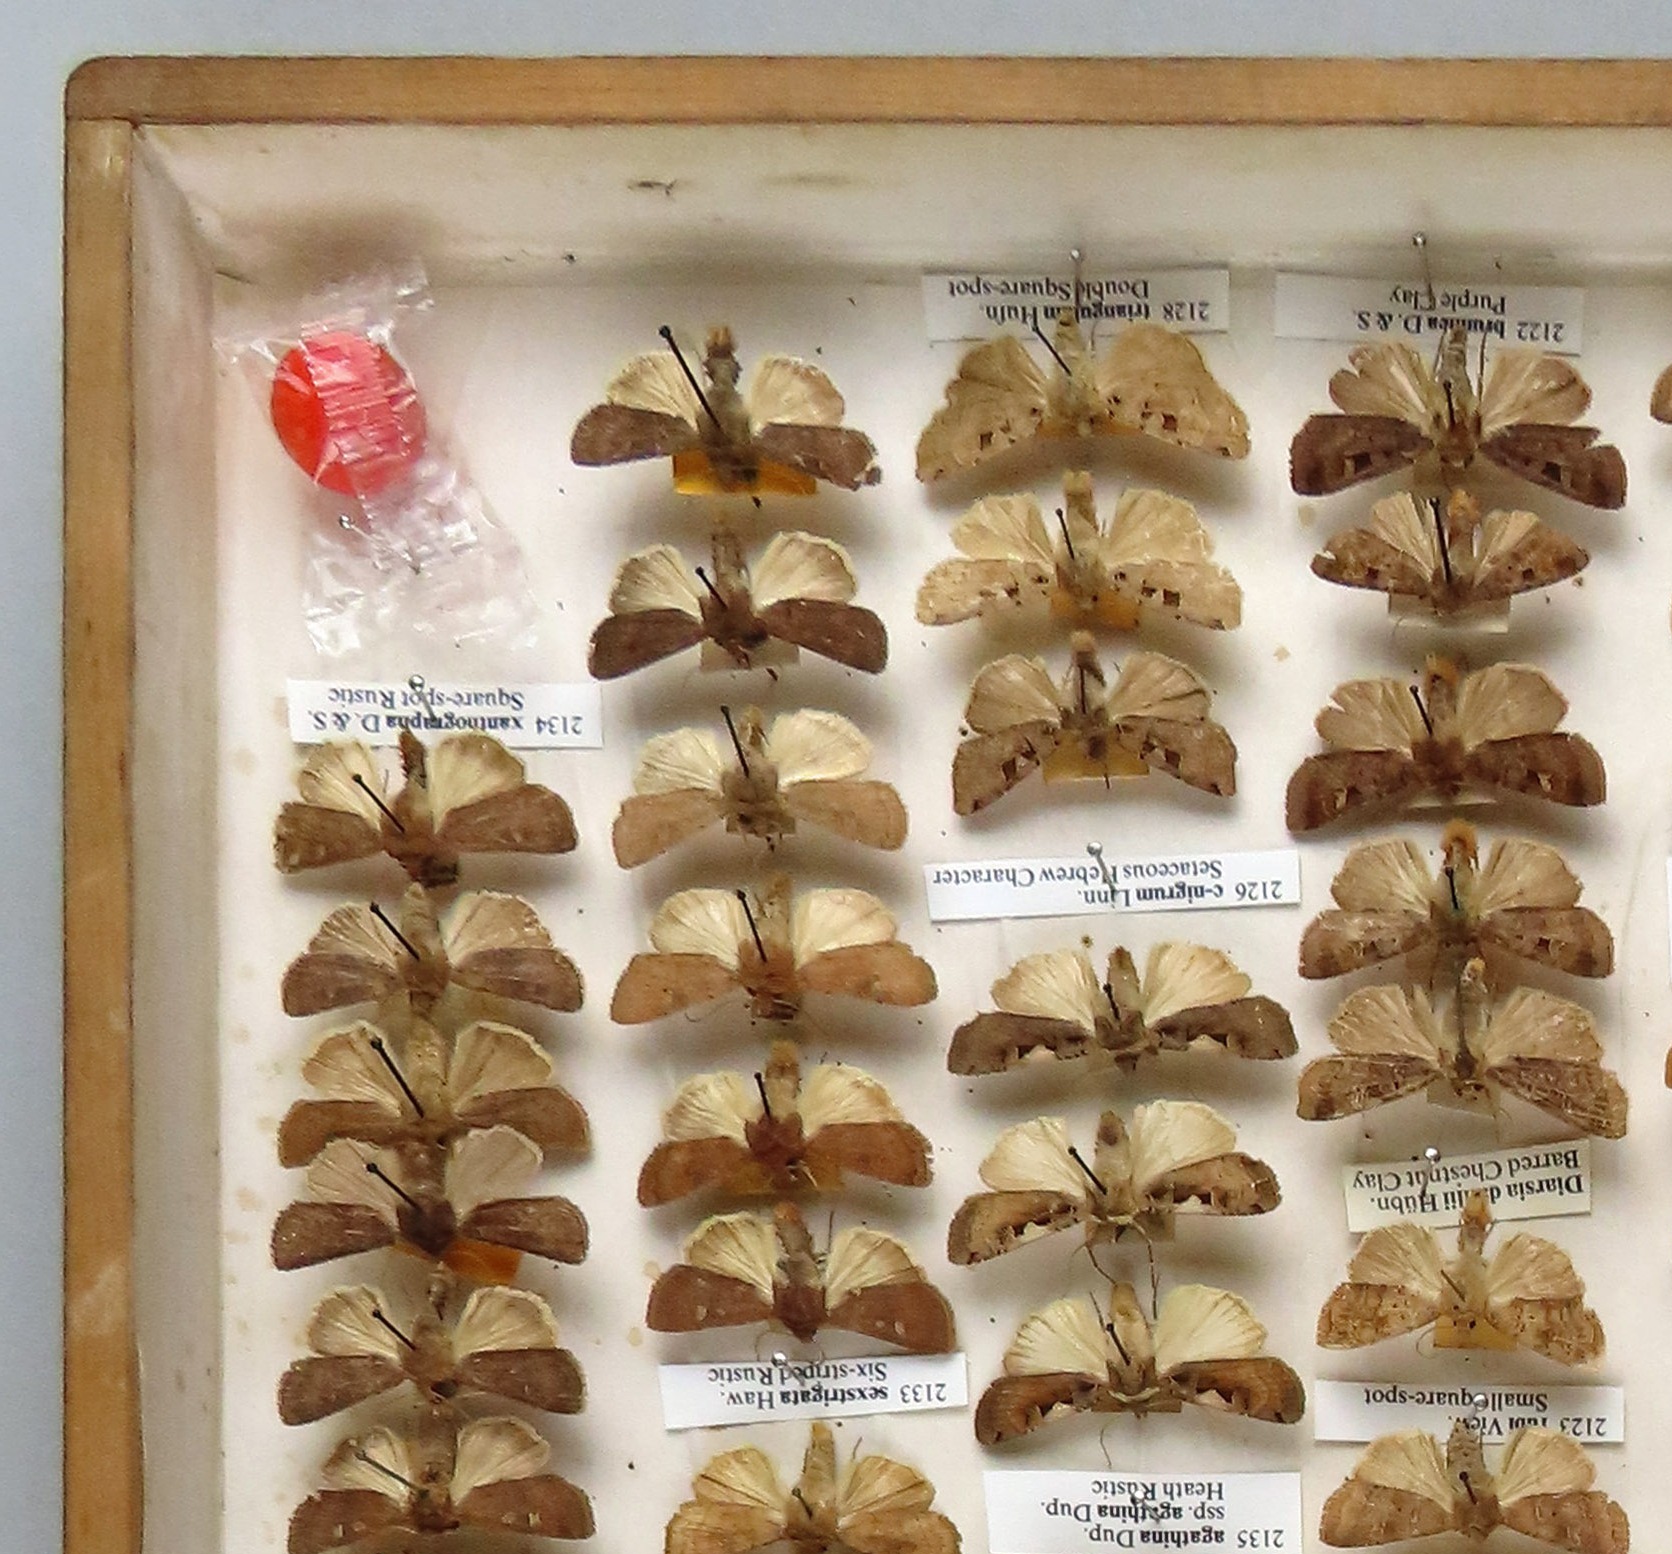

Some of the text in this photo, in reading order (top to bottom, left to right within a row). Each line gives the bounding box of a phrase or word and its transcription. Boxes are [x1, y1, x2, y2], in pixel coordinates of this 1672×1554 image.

[949, 279, 1070, 299] Square-spot
[1389, 289, 1506, 312] Purple Clay
[1163, 303, 1210, 321] 2128
[1353, 311, 1564, 341] 2122 D. & S.
[328, 688, 524, 710] Square-spot Rustic
[308, 712, 583, 734] 2134 D. & S.
[933, 867, 1034, 889] Character
[1123, 860, 1222, 882] Setaceous
[1077, 881, 1282, 907] 2126 c-nigrum Linn.
[1507, 1150, 1579, 1177] Barred
[1352, 1170, 1400, 1193] Clay
[1506, 1173, 1583, 1201] Diarsia
[707, 1367, 772, 1386] Rustic
[720, 1382, 947, 1409] 2133 sexstrigata Haw.
[1492, 1392, 1548, 1411] Small
[1162, 1482, 1223, 1499] Heath
[1041, 1501, 1225, 1521] ssp. Dup.
[1084, 1524, 1284, 1548] 2135 agathina Dup.
